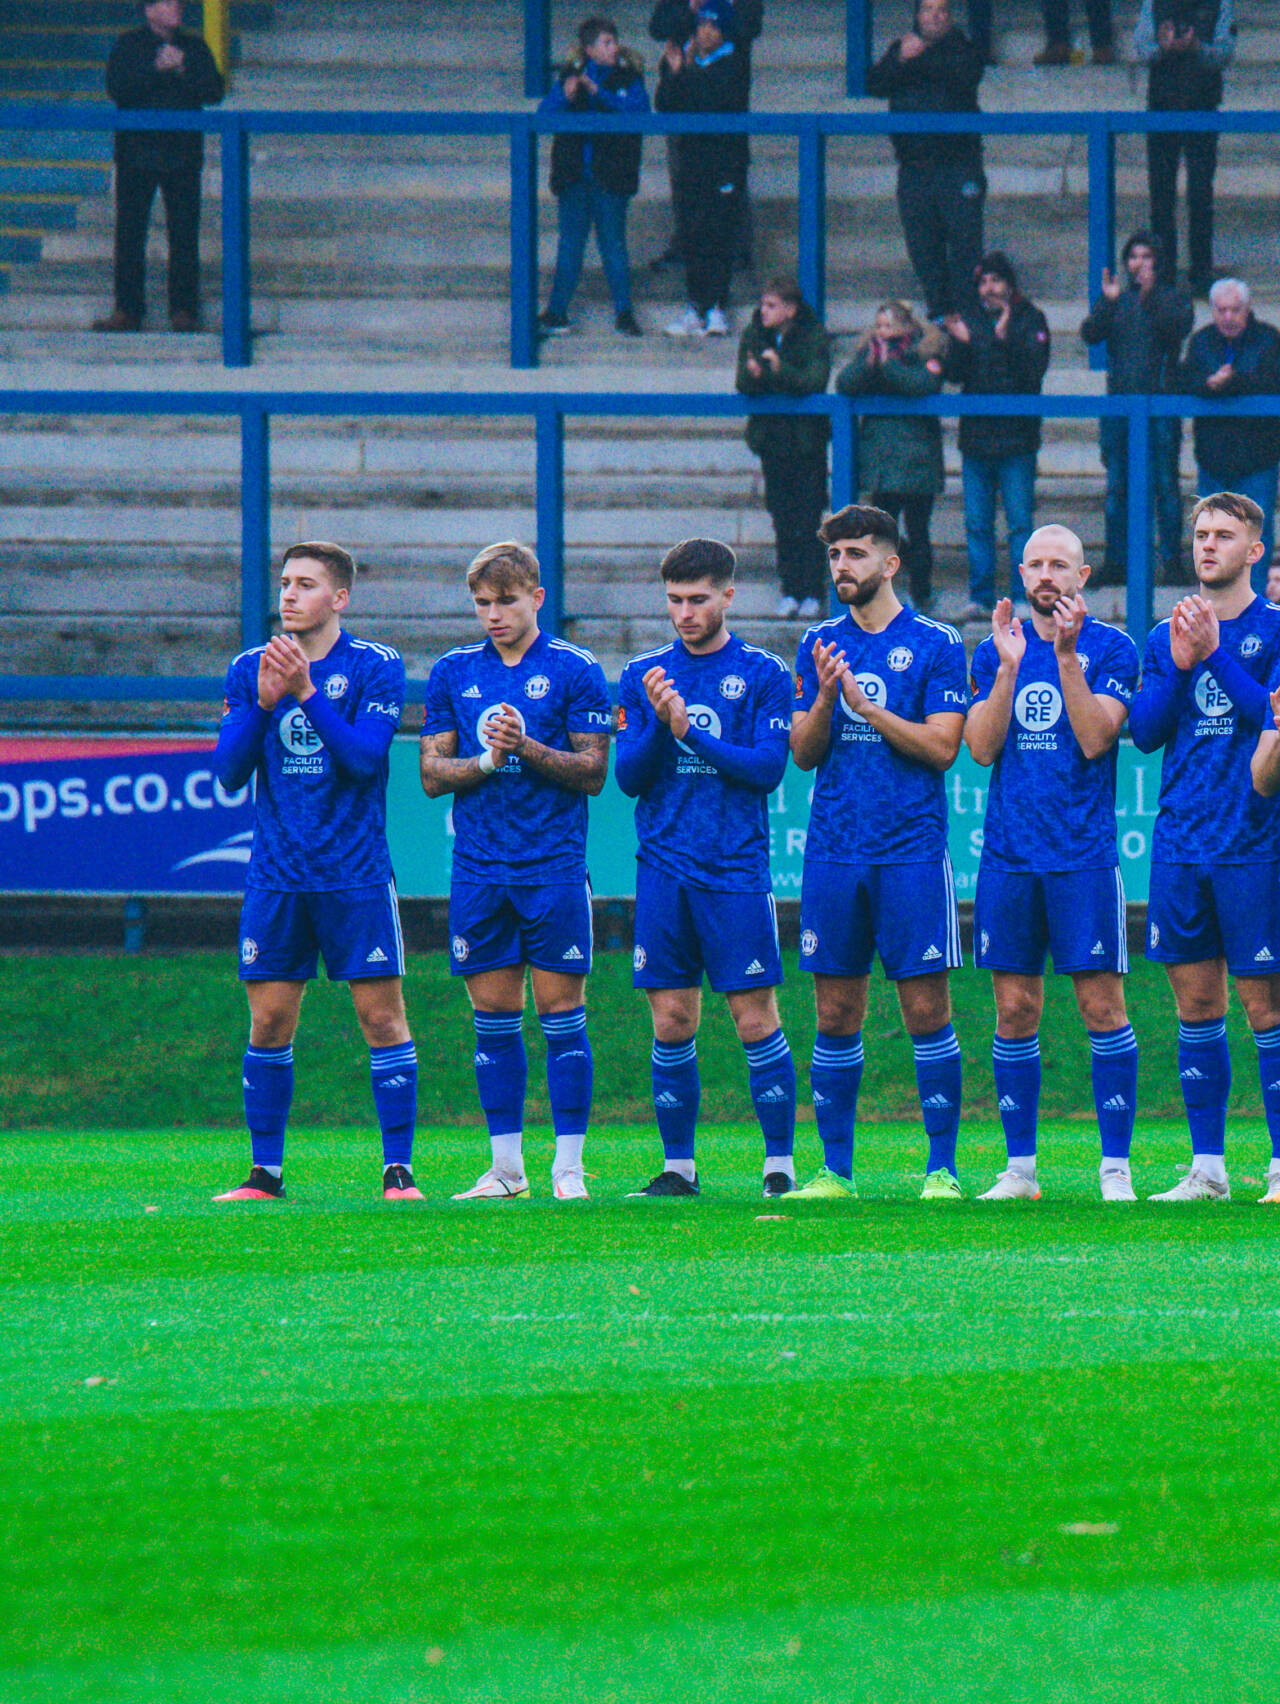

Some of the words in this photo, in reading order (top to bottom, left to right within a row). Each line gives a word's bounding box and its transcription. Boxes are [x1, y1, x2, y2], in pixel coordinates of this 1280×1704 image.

[1025, 690, 1053, 706] CO
[1025, 707, 1051, 722] RE
[1198, 717, 1234, 727] FACILITY
[1194, 727, 1233, 736] SERVICES
[841, 733, 881, 743] SERVICES
[1017, 733, 1057, 741] FACILITY
[1017, 742, 1058, 750] SERVICES
[283, 757, 323, 765] FACILITY
[281, 765, 324, 774] SERVICES
[676, 766, 717, 774] SERVICES
[0, 769, 258, 833] ops.co.co
